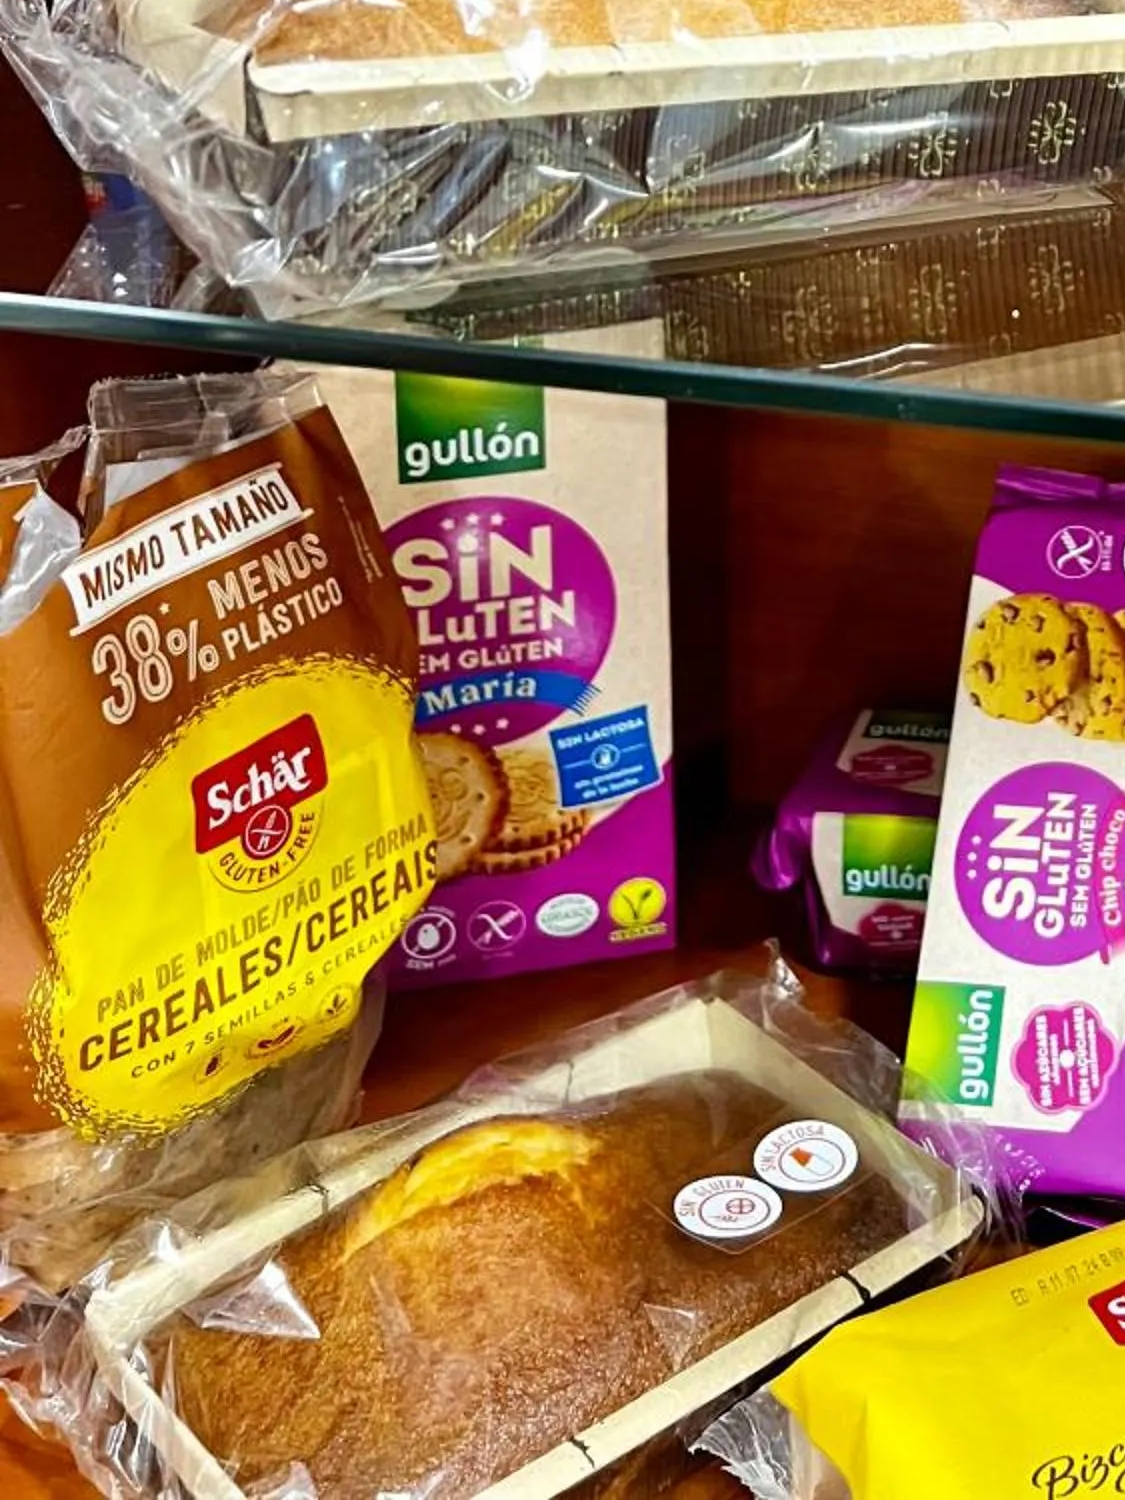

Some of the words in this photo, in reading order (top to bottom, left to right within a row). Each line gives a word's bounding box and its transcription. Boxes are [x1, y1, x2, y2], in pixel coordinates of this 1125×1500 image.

[405, 422, 541, 477] gullón
[78, 534, 165, 609] MISMO
[169, 478, 290, 558] TAMAÑO
[206, 532, 329, 621] MENOS
[221, 577, 344, 661] PLÁSTICO
[417, 590, 576, 646] LuTEN
[421, 671, 538, 717] María
[206, 745, 313, 829] Schär
[218, 810, 316, 884] GLUTEN-FREE
[97, 976, 145, 1024] PAN
[155, 952, 186, 989] DE
[330, 852, 356, 891] DE
[363, 813, 430, 869] FORMA
[1070, 881, 1088, 928] SEM
[1102, 875, 1124, 927] Chip
[130, 1050, 177, 1079] CON
[203, 982, 299, 1047] SEMILLAS
[957, 988, 994, 1099] gullón
[1035, 1014, 1051, 1083] AZÚCARES
[1040, 1084, 1053, 1107] SIN
[768, 1124, 826, 1156] LACTOSA
[692, 1179, 746, 1199] GLUTEN
